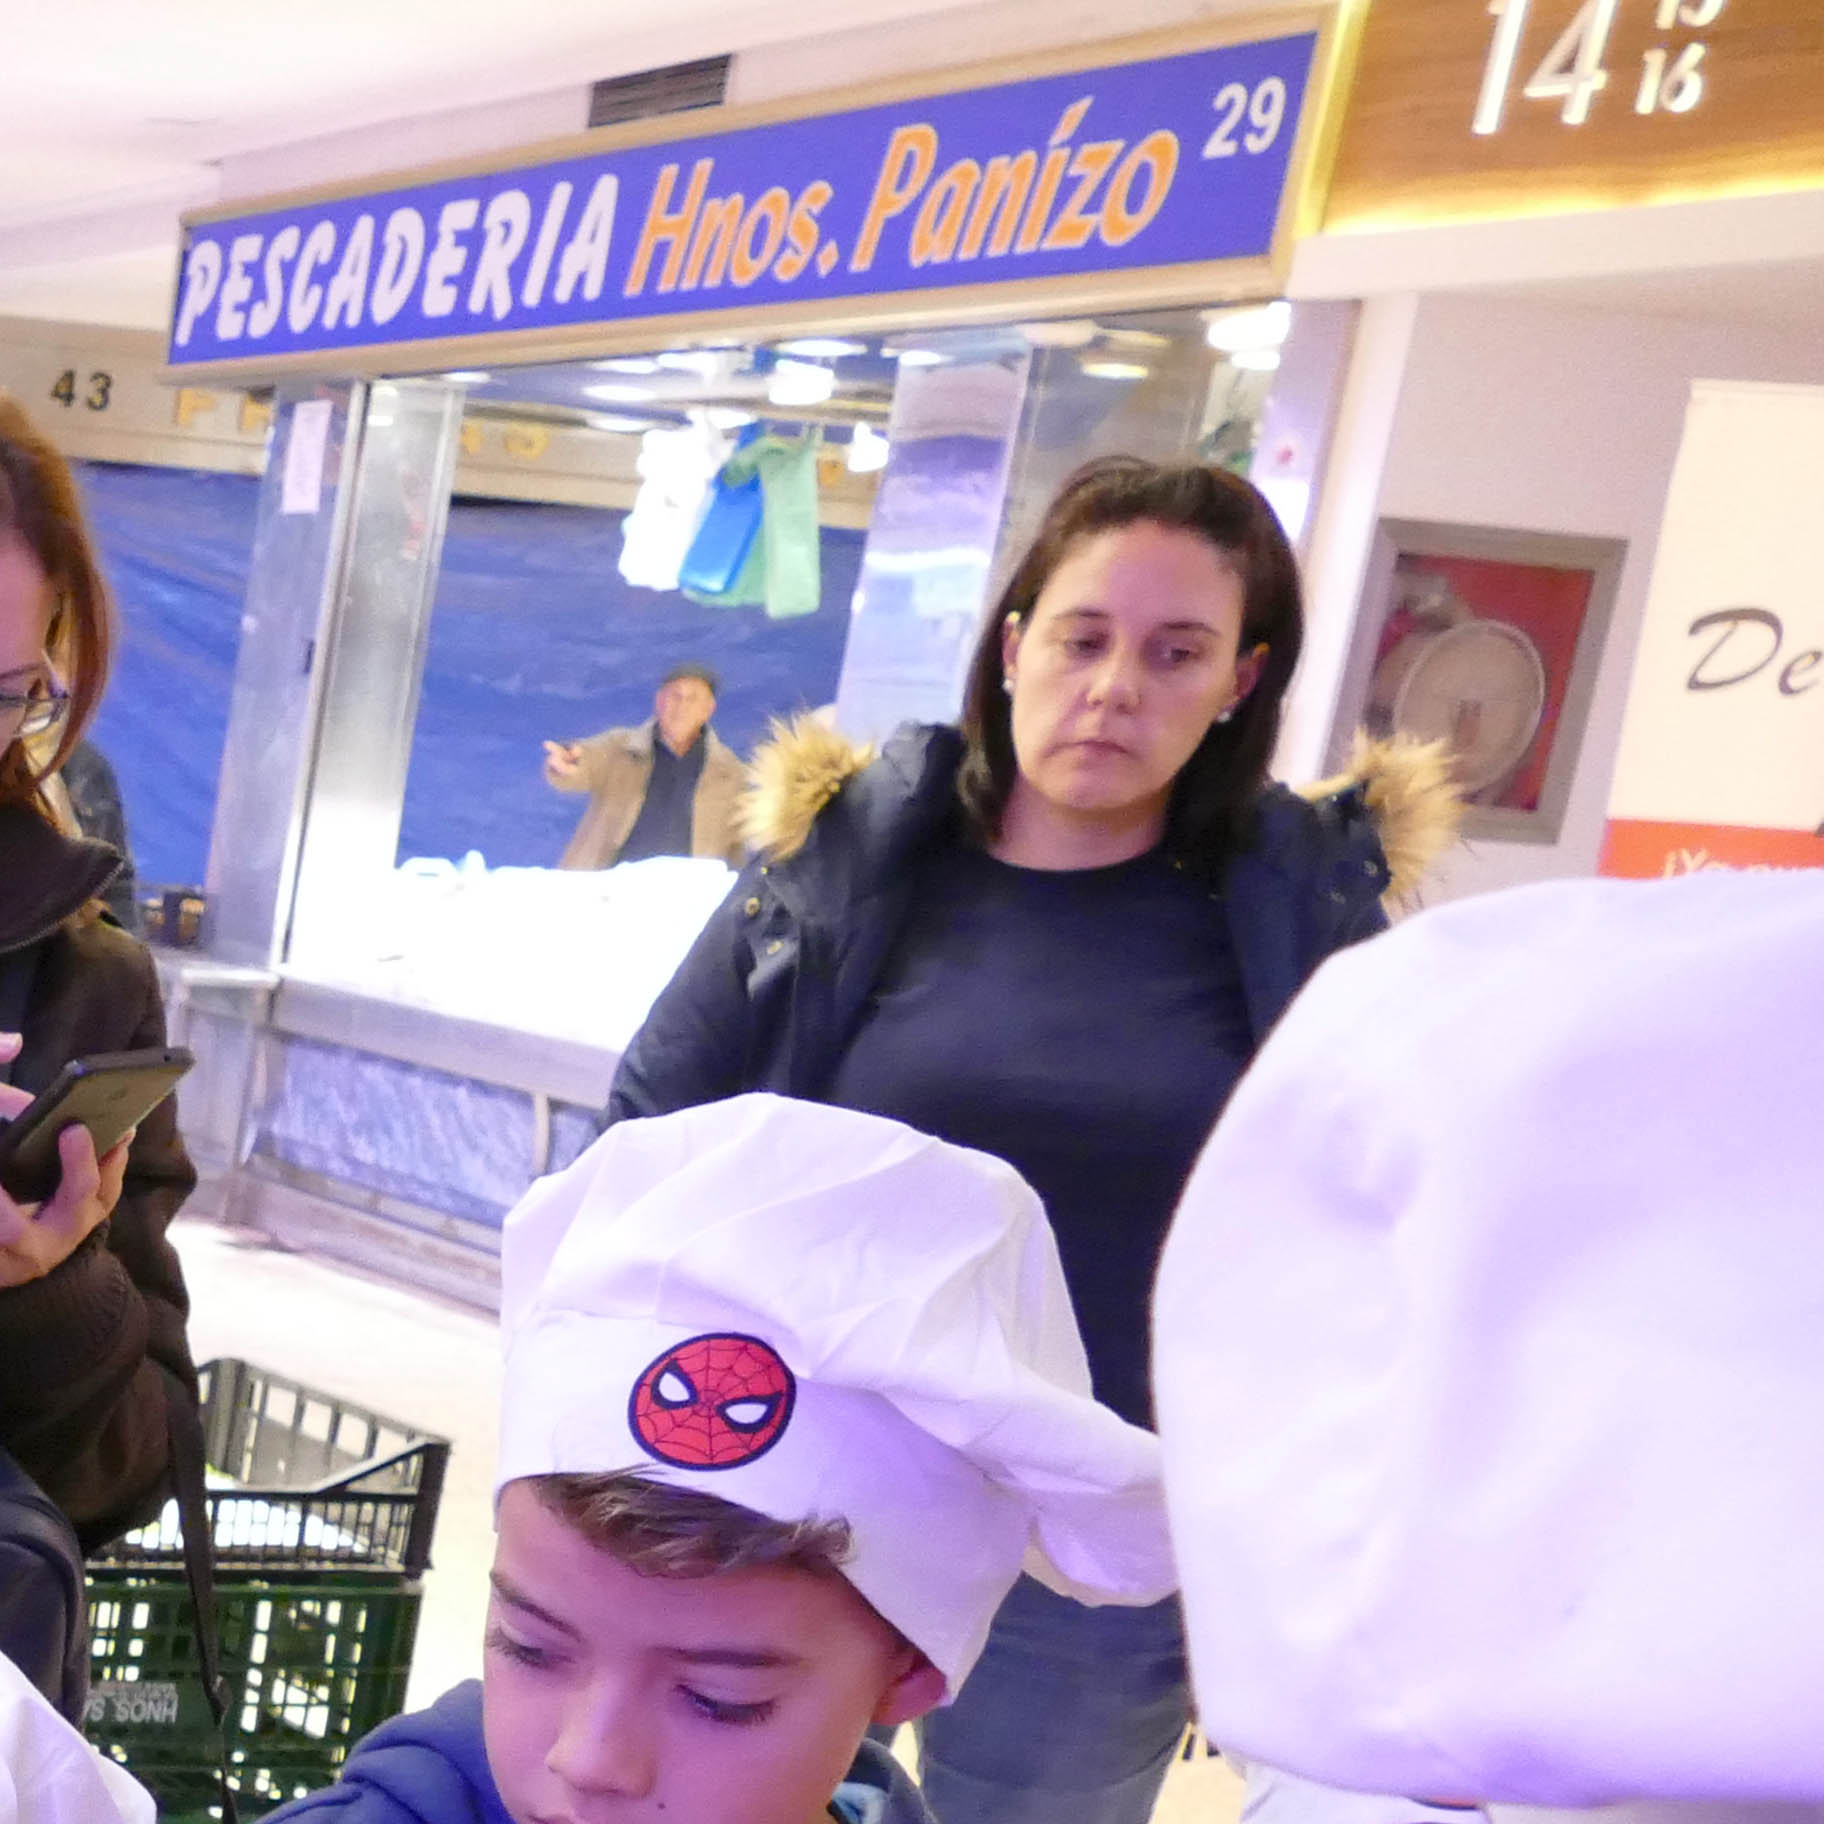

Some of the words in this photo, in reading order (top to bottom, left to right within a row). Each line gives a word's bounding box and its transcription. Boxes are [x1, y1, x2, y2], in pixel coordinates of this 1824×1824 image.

[1472, 0, 1616, 135] 14
[1635, 43, 1707, 114] 16
[175, 173, 619, 346] PESCADERIA
[623, 157, 840, 296] Hnos.
[849, 96, 1180, 272] Panízo
[1202, 77, 1286, 159] 29
[51, 369, 113, 411] 43
